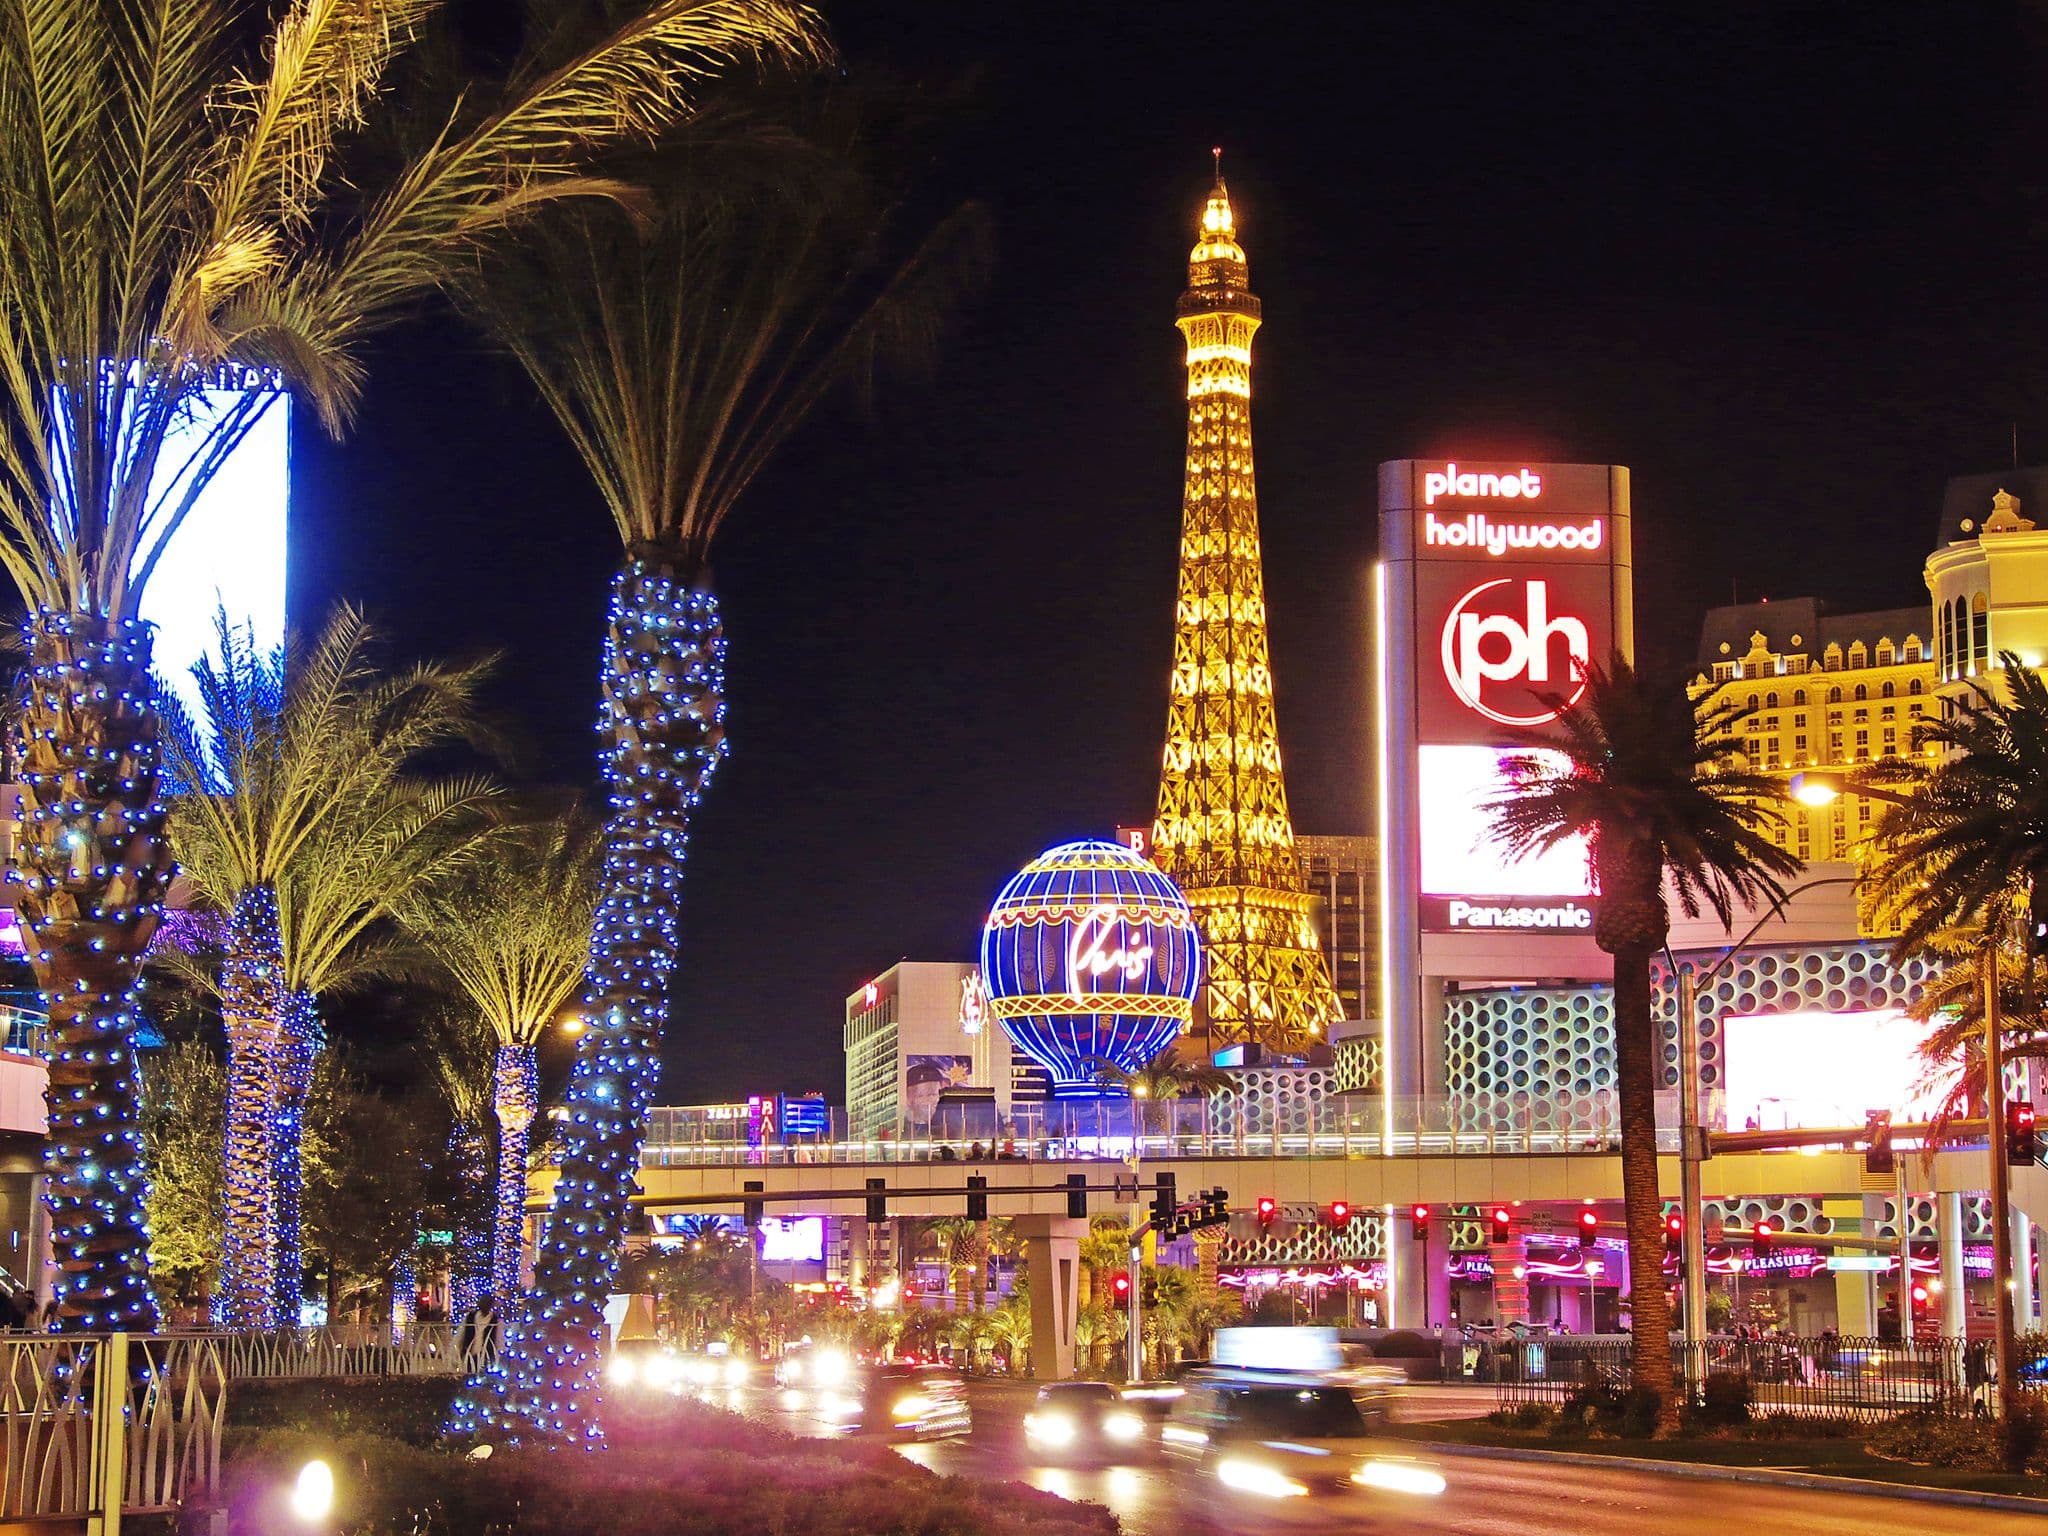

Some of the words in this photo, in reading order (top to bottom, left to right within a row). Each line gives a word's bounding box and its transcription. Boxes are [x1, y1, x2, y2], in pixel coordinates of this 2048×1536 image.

[1425, 463, 1542, 504] planet
[1426, 513, 1602, 556] hollywood
[1459, 580, 1589, 703] ph
[1450, 901, 1591, 928] Panasonic
[1744, 1254, 1812, 1270] PLEASURE
